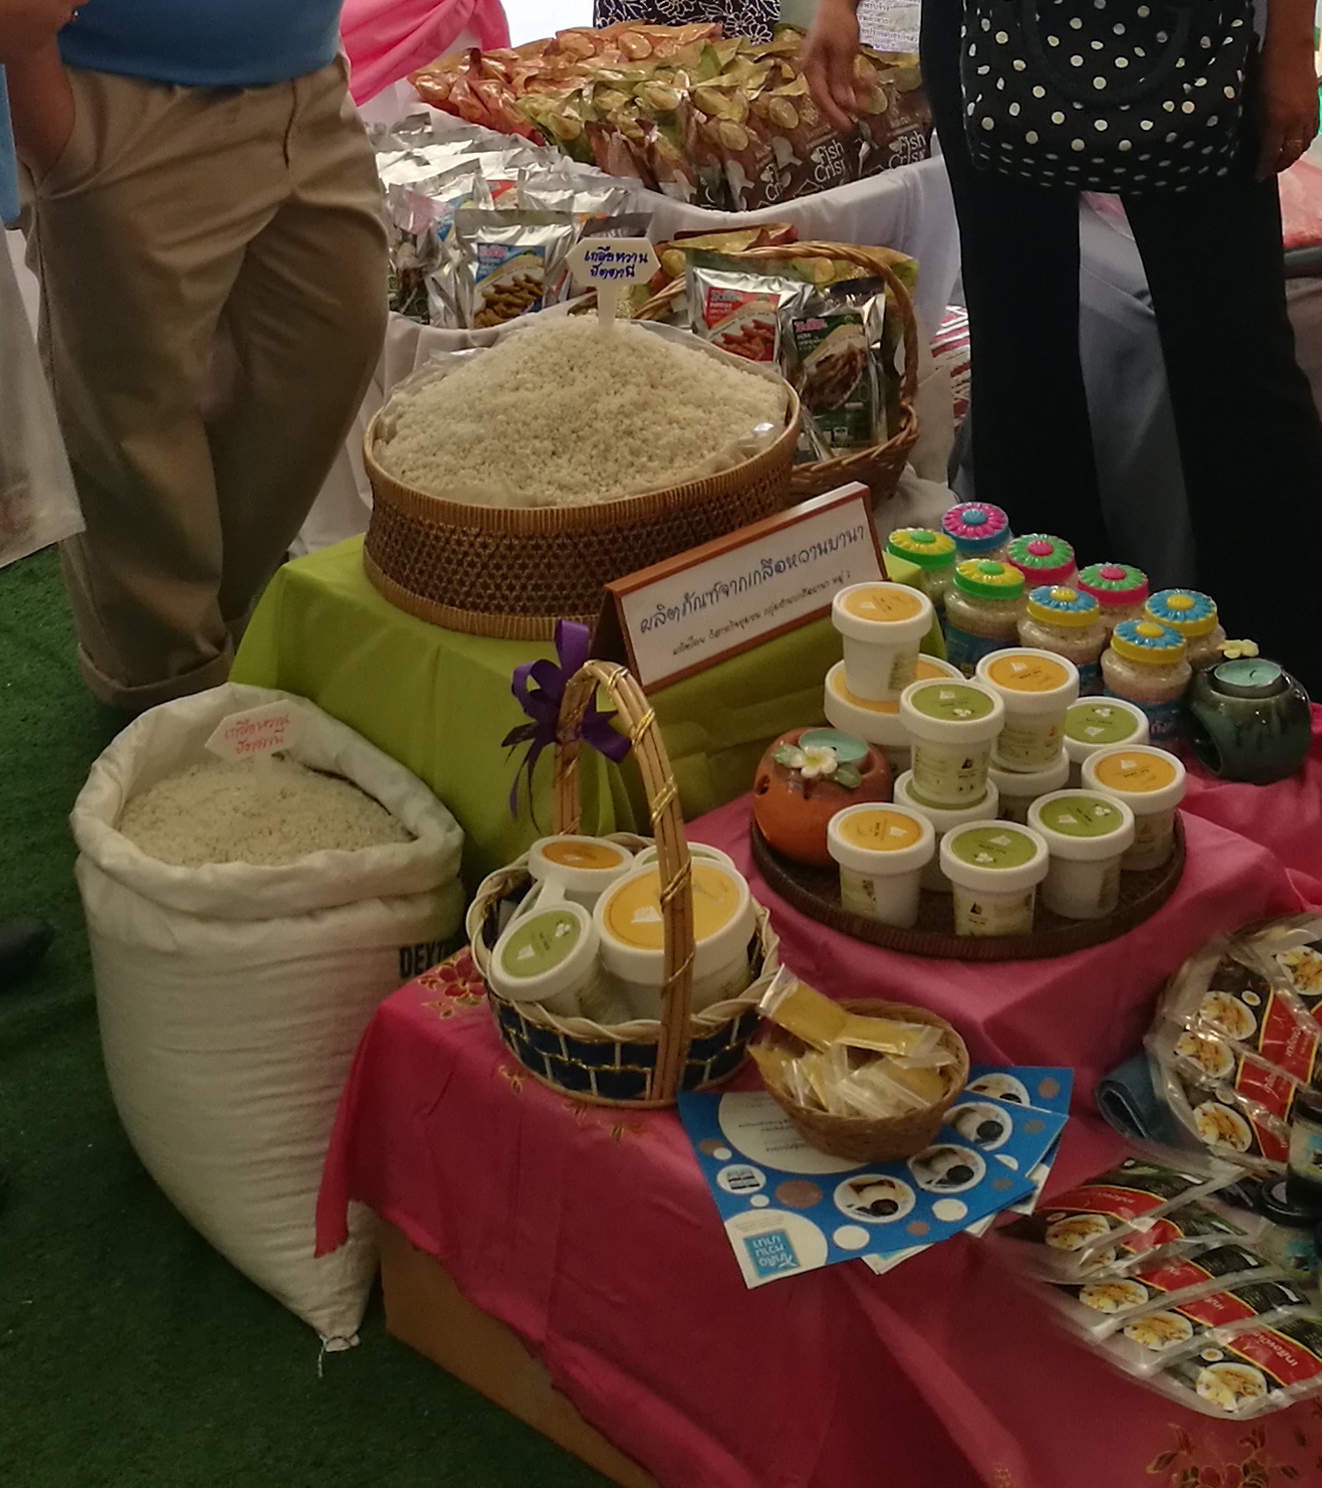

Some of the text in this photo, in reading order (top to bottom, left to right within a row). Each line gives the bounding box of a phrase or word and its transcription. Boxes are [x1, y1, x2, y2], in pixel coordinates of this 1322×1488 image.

[640, 525, 865, 634] ผลิตภัณฑ์จากเกลือหวานบานา
